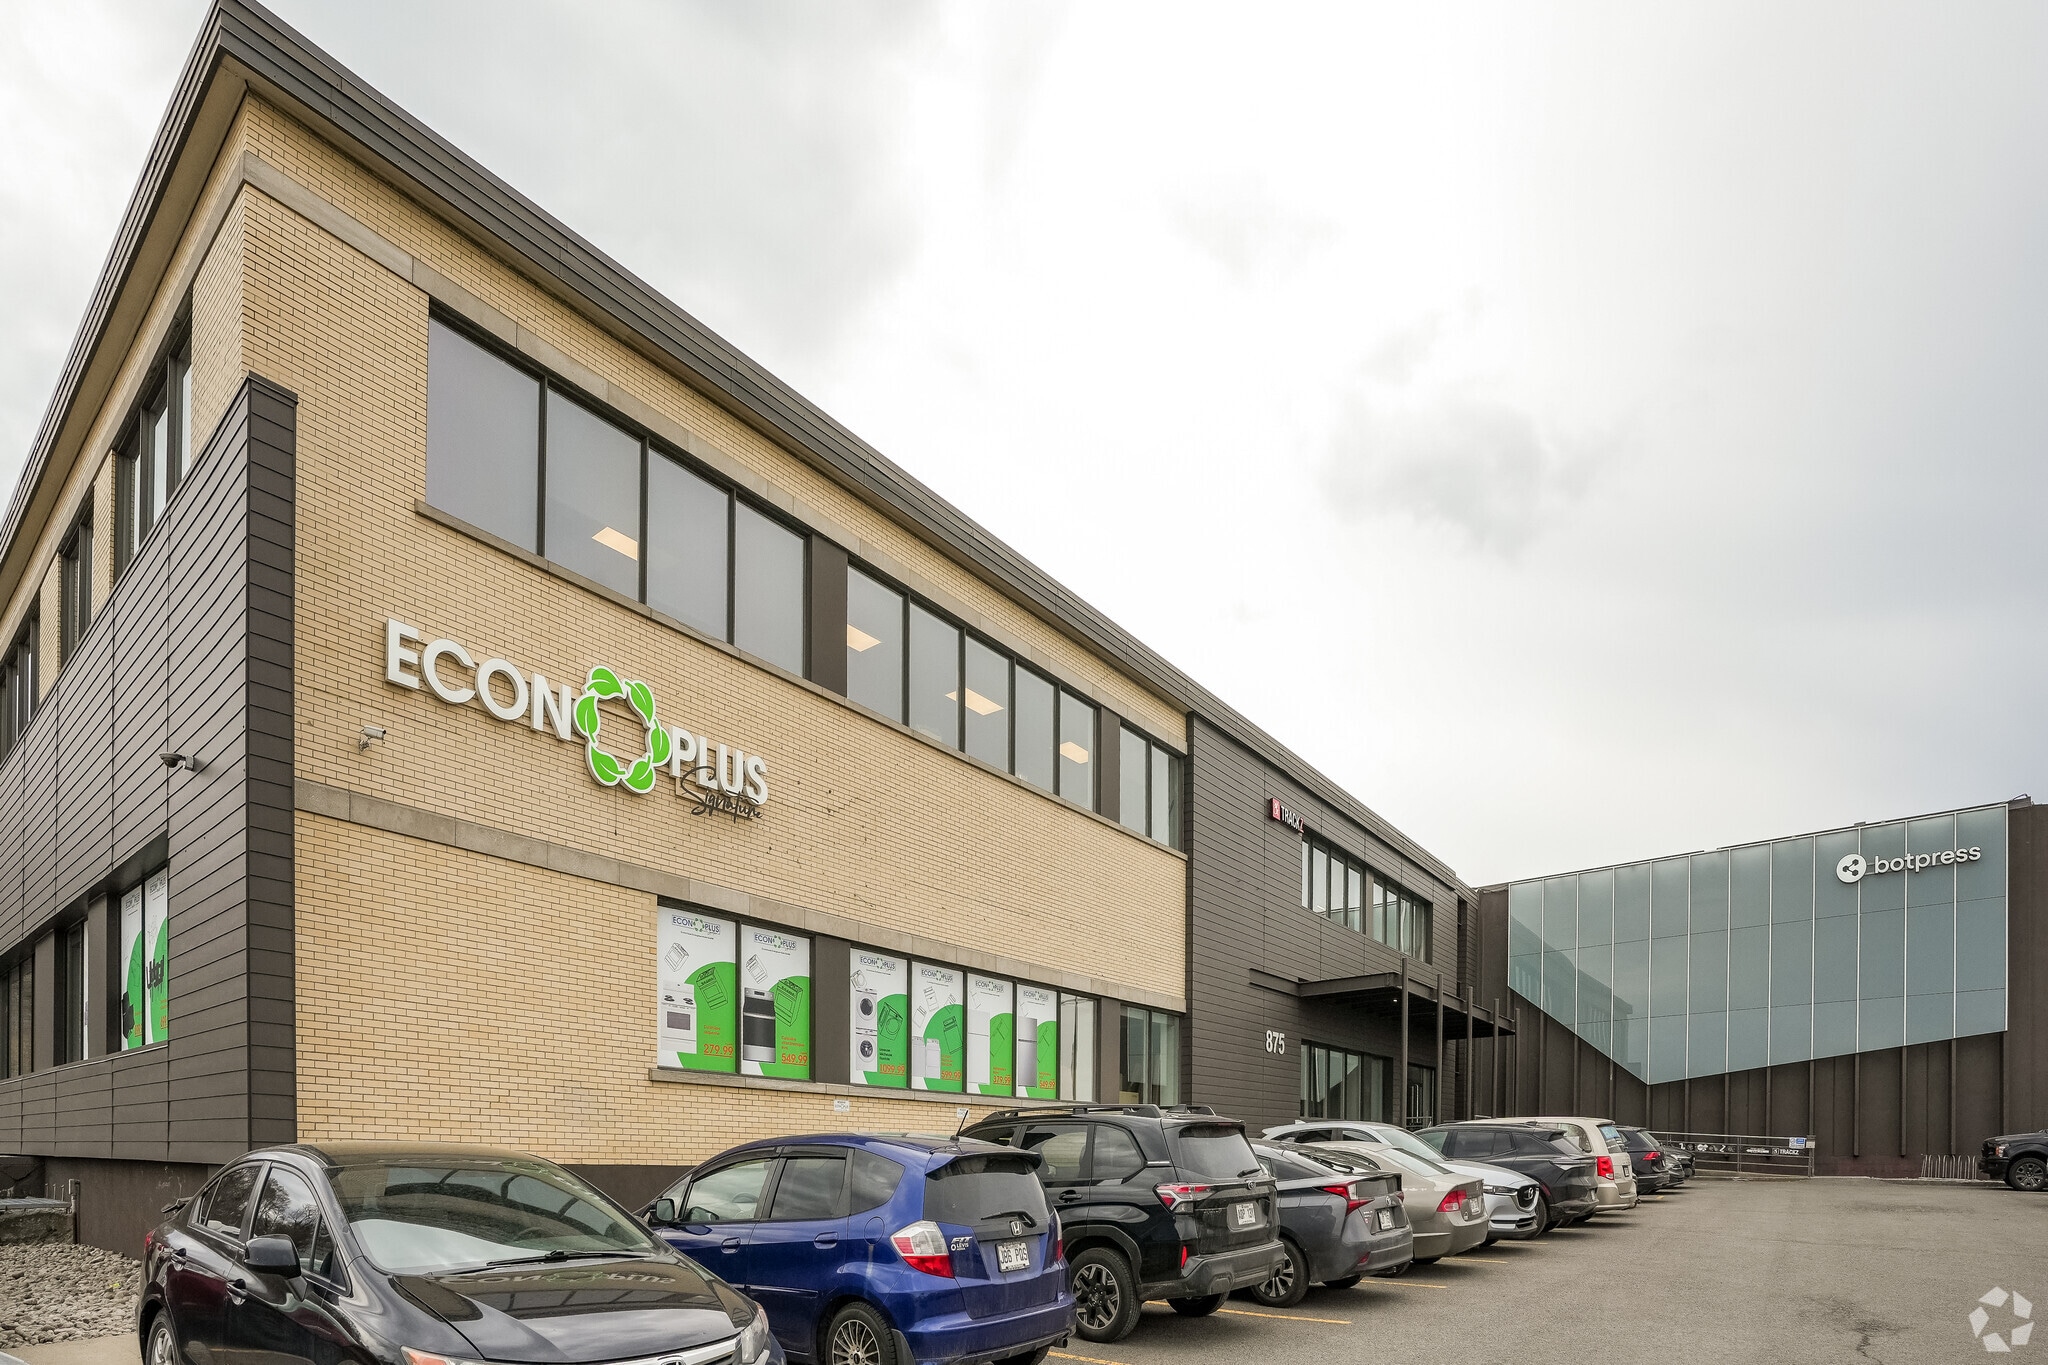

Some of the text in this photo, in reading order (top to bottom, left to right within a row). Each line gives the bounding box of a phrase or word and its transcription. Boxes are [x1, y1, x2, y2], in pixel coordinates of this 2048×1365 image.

[680, 766, 763, 824] Signature
[1874, 846, 1981, 873] botpress
[703, 1044, 733, 1056] 279.99
[1266, 1030, 1285, 1055] 875
[781, 1053, 808, 1064] 549.99
